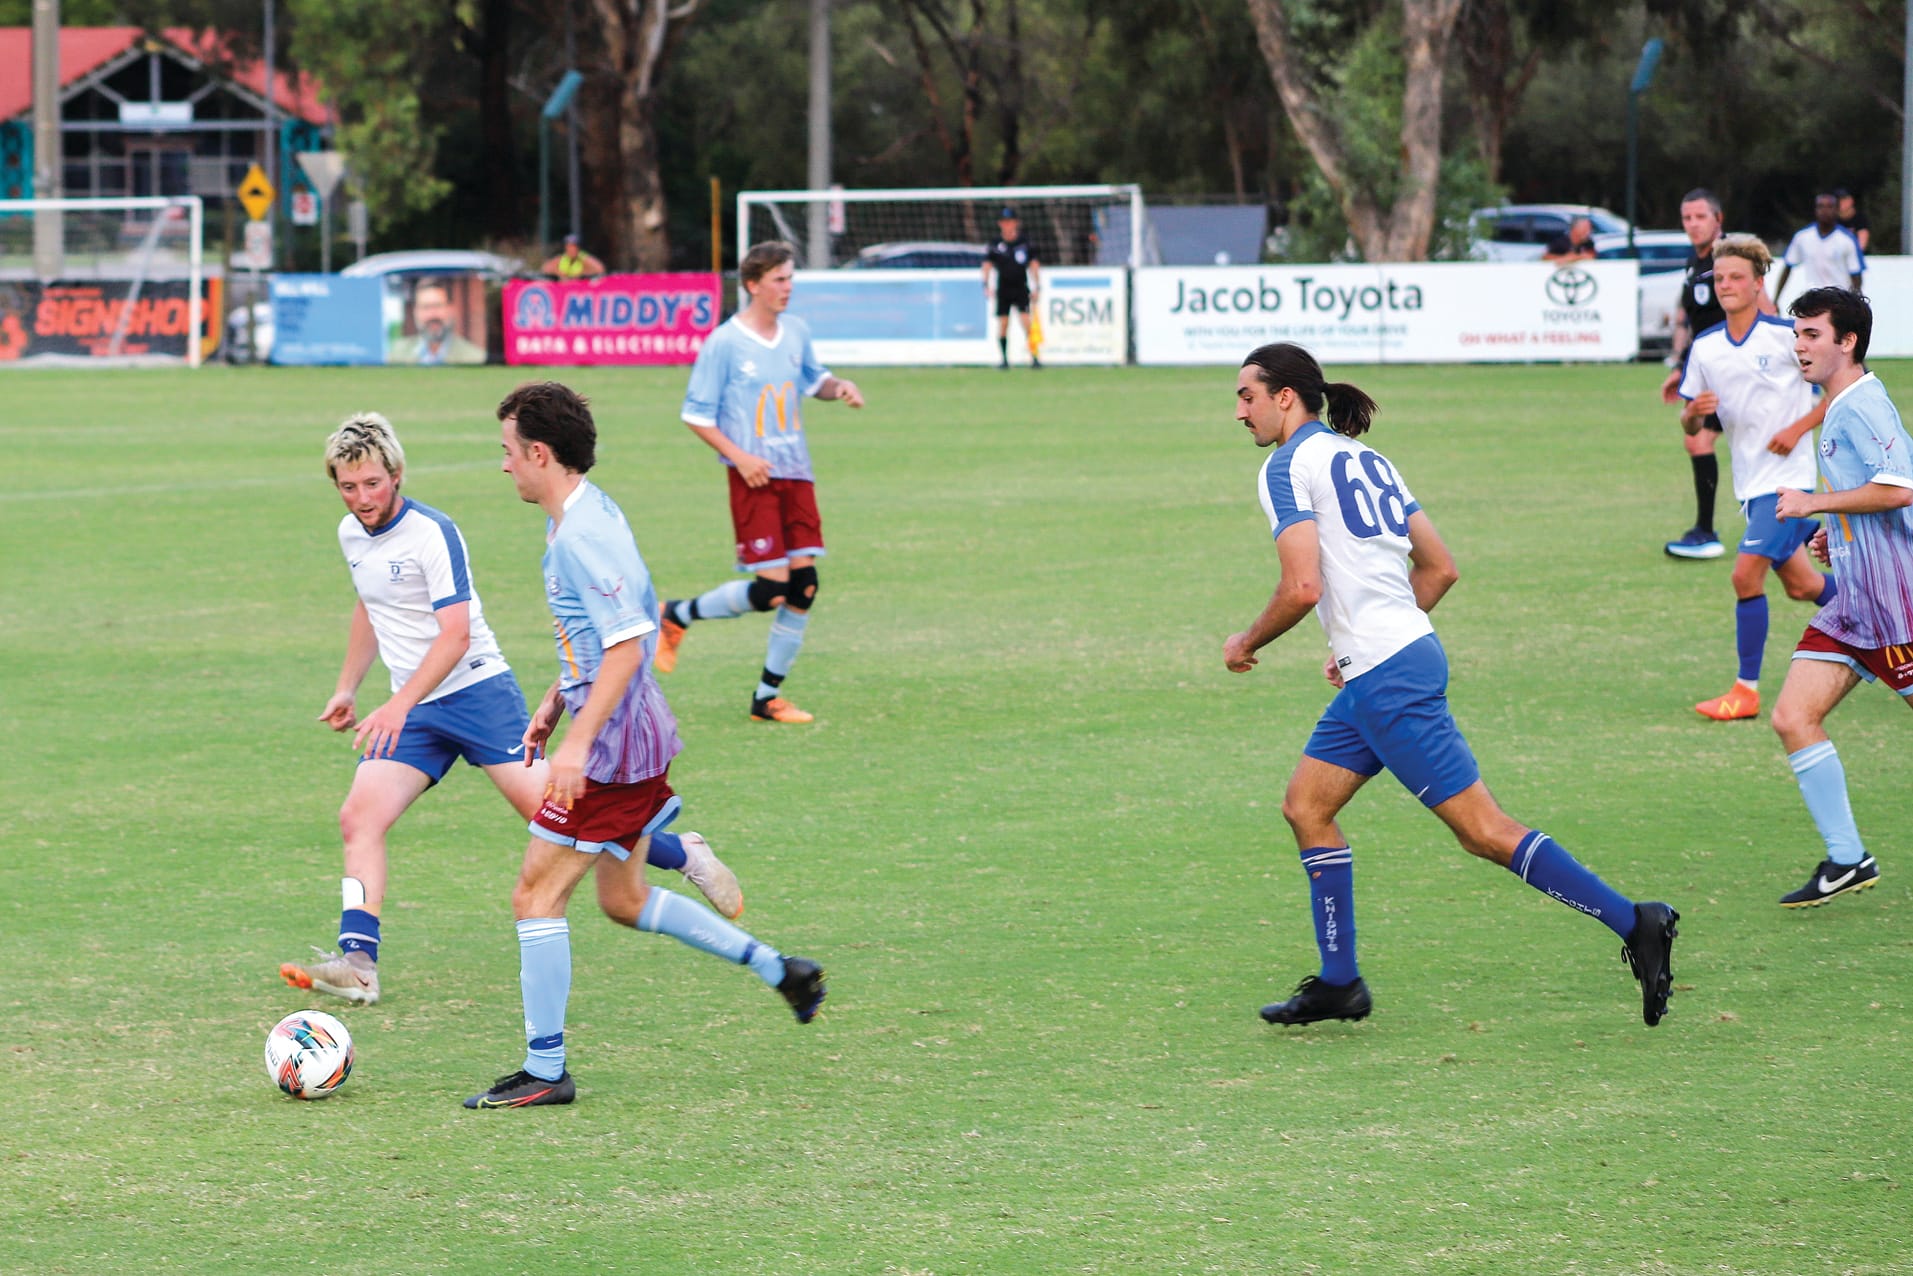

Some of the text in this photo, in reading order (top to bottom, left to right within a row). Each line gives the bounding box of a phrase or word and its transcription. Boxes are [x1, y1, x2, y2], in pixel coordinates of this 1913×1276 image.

[563, 295, 712, 327] MIDDY'S
[1049, 297, 1112, 325] RSM
[1170, 276, 1423, 321] Jacob Toyota
[1542, 310, 1601, 323] TOYOTA
[516, 336, 567, 354] DATA
[592, 335, 704, 353] ELECTRICA
[1484, 331, 1526, 344] WHAT
[1543, 331, 1601, 344] FEELING
[1330, 450, 1411, 539] 68
